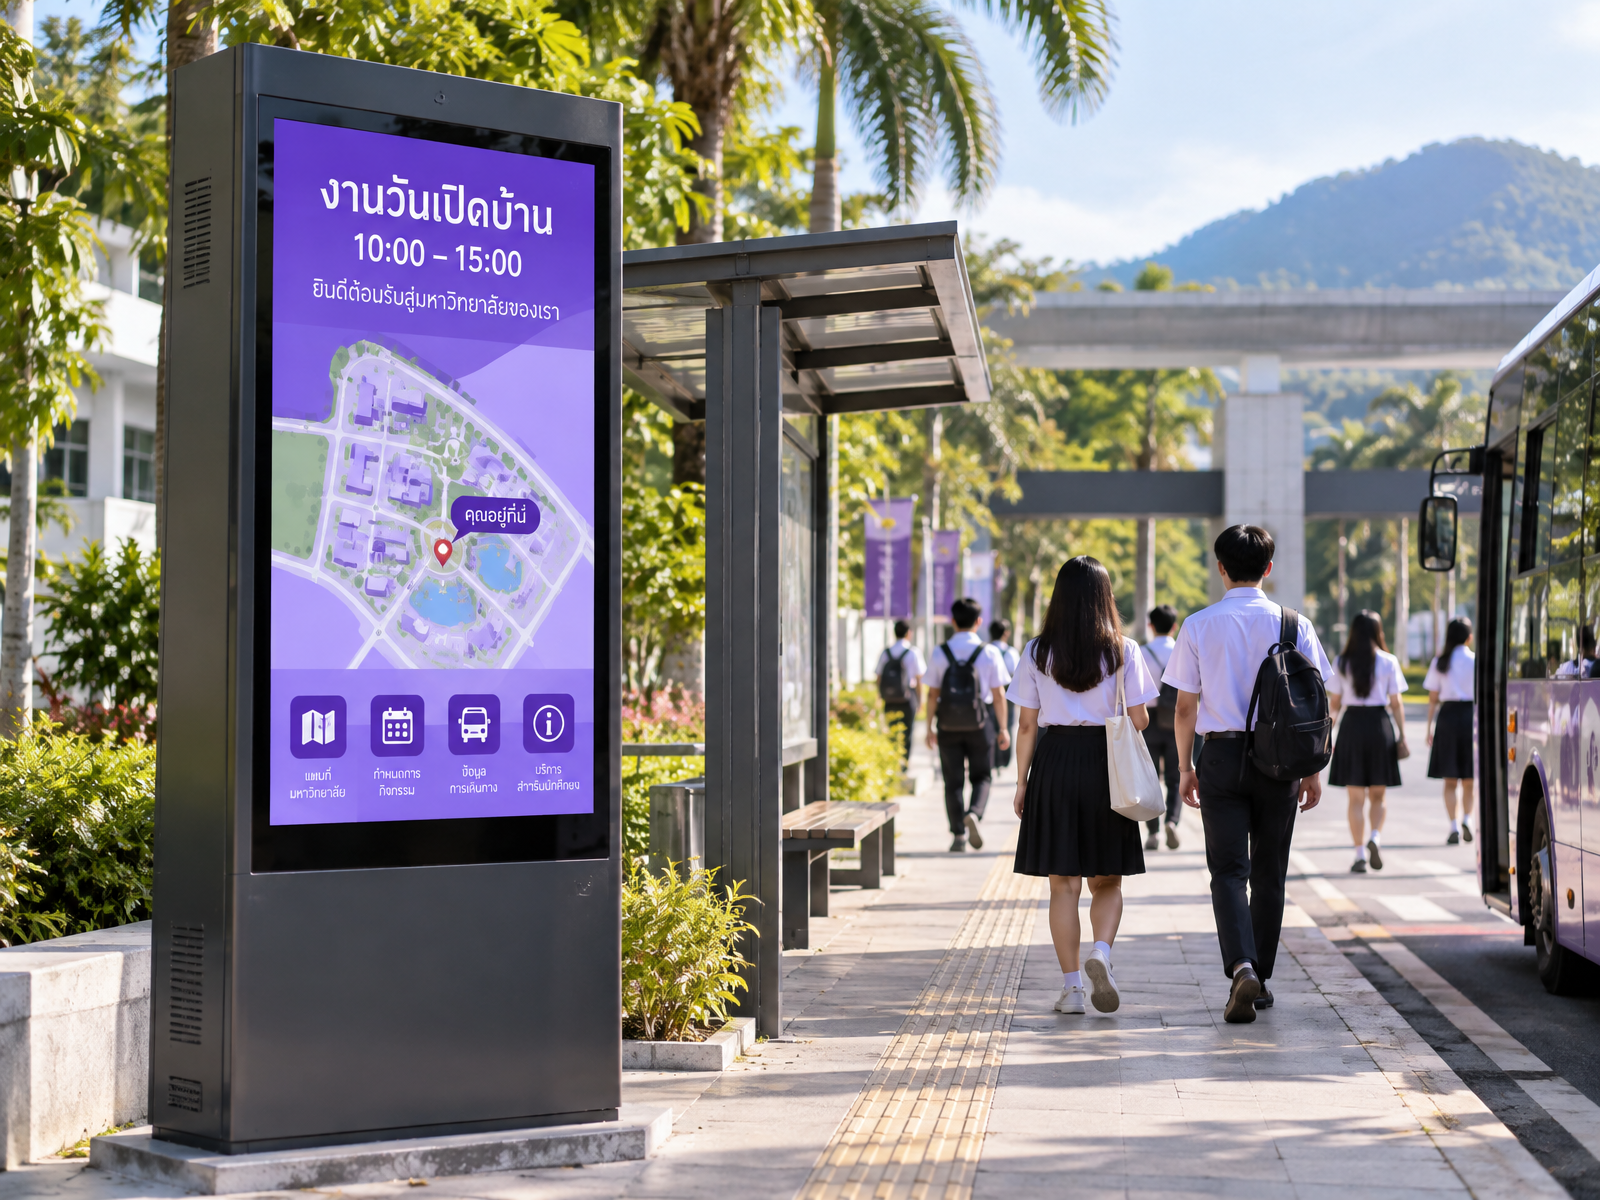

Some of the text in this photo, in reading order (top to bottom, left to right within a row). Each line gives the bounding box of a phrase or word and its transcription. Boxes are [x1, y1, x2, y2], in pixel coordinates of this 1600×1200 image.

[320, 174, 553, 235] งานวันเปิดบ้าน
[354, 232, 425, 267] 10:00
[455, 244, 522, 277] 15:00
[312, 277, 560, 321] ยินดีต้อนรับสู่มหาวิทยาลัยของเรา
